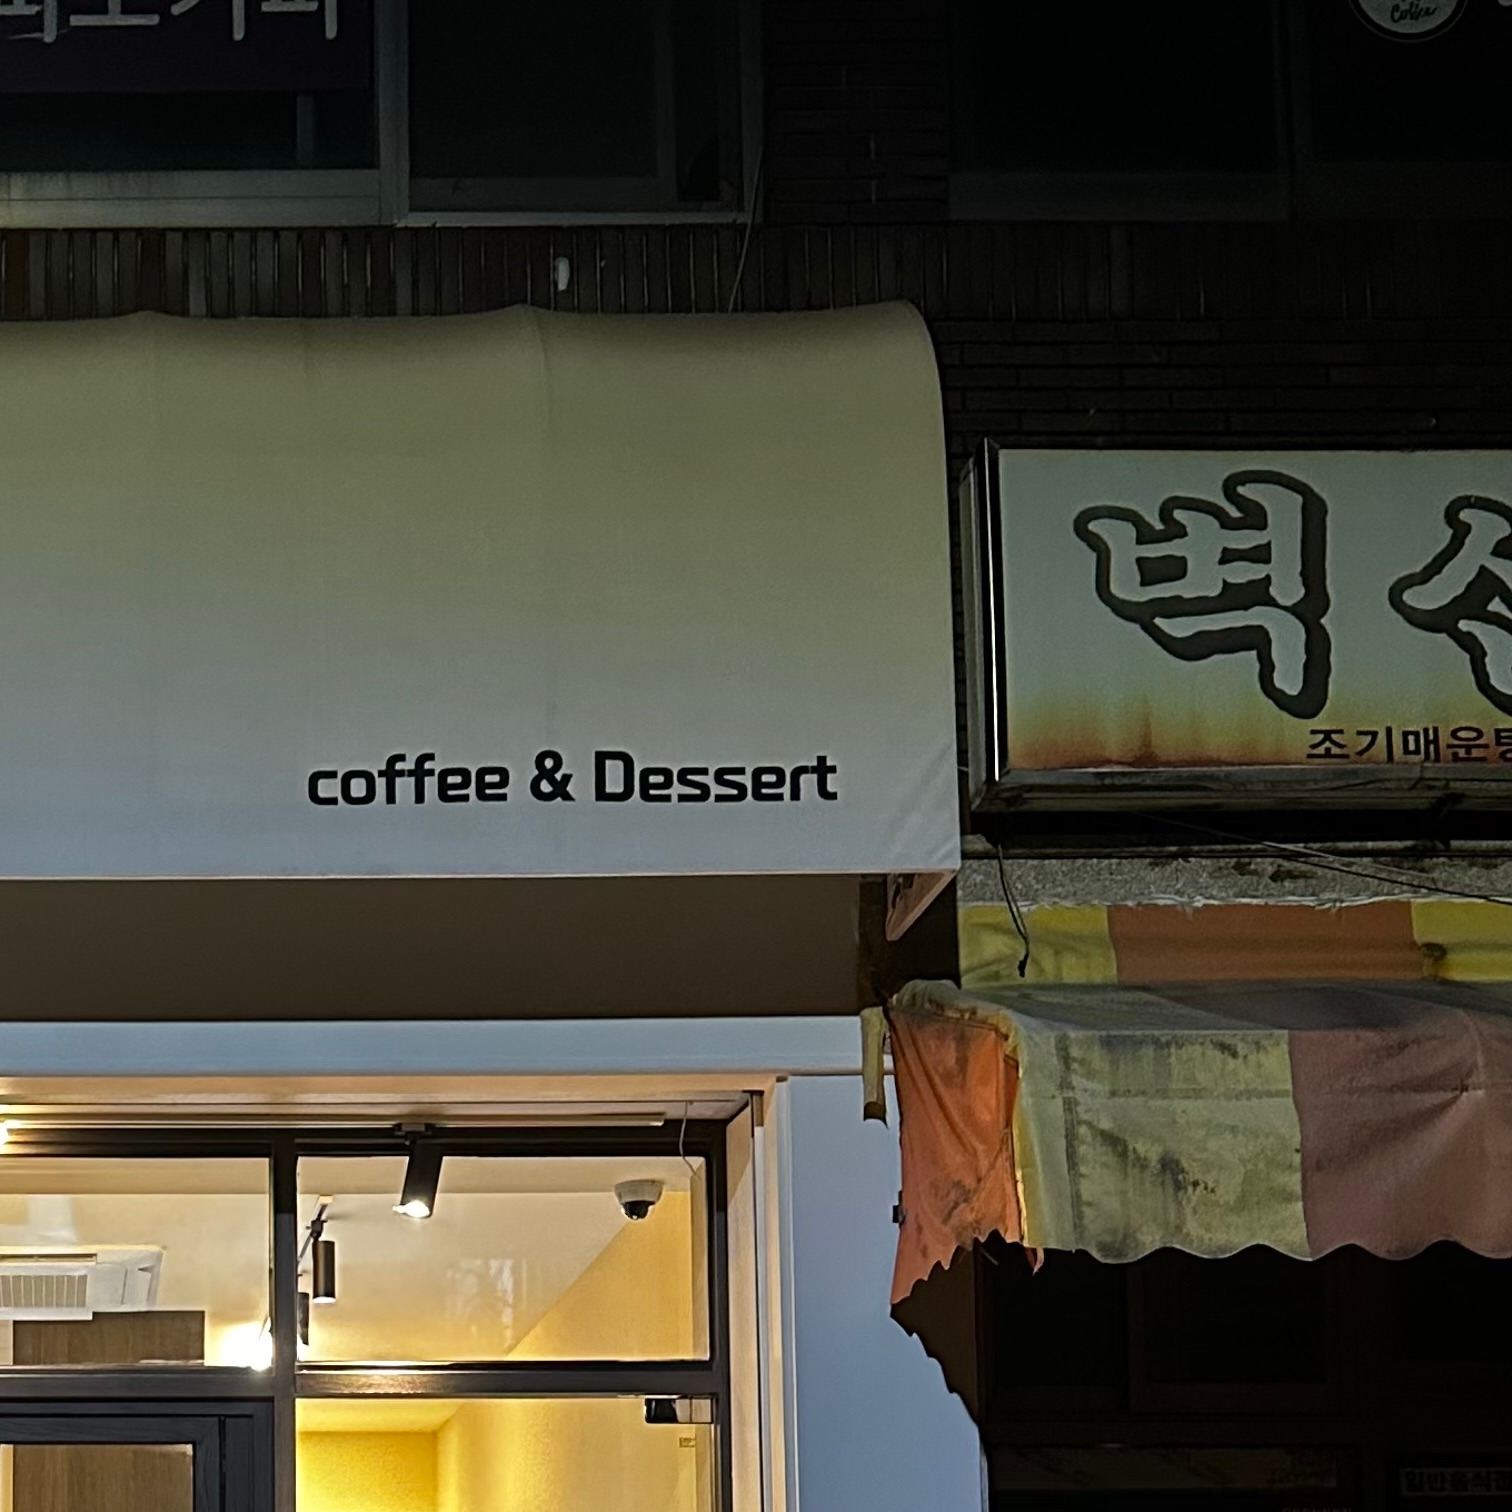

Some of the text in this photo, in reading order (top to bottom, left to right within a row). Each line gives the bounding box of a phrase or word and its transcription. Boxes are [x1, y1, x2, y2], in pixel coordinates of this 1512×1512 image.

[307, 749, 838, 806] coffee & Dessert
